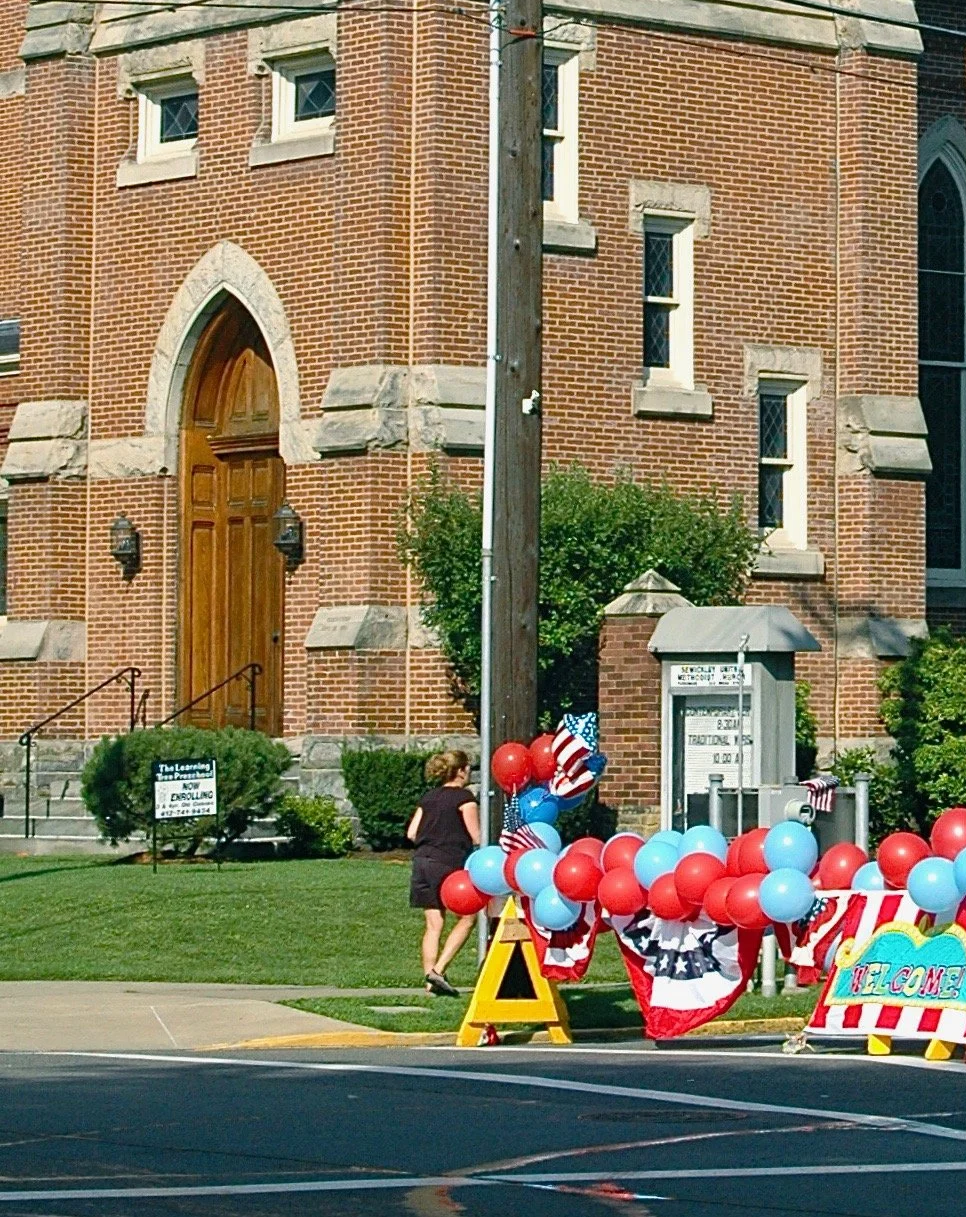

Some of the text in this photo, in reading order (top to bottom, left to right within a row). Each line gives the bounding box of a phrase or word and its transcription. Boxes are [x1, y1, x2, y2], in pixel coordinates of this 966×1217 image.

[688, 735, 730, 746] TRADITIONAL
[159, 762, 210, 772] The Learning
[156, 770, 214, 781] Tree Preschool
[183, 782, 200, 790] NOW
[171, 790, 213, 801] ENROLLING
[851, 961, 966, 1000] WELCOME!
